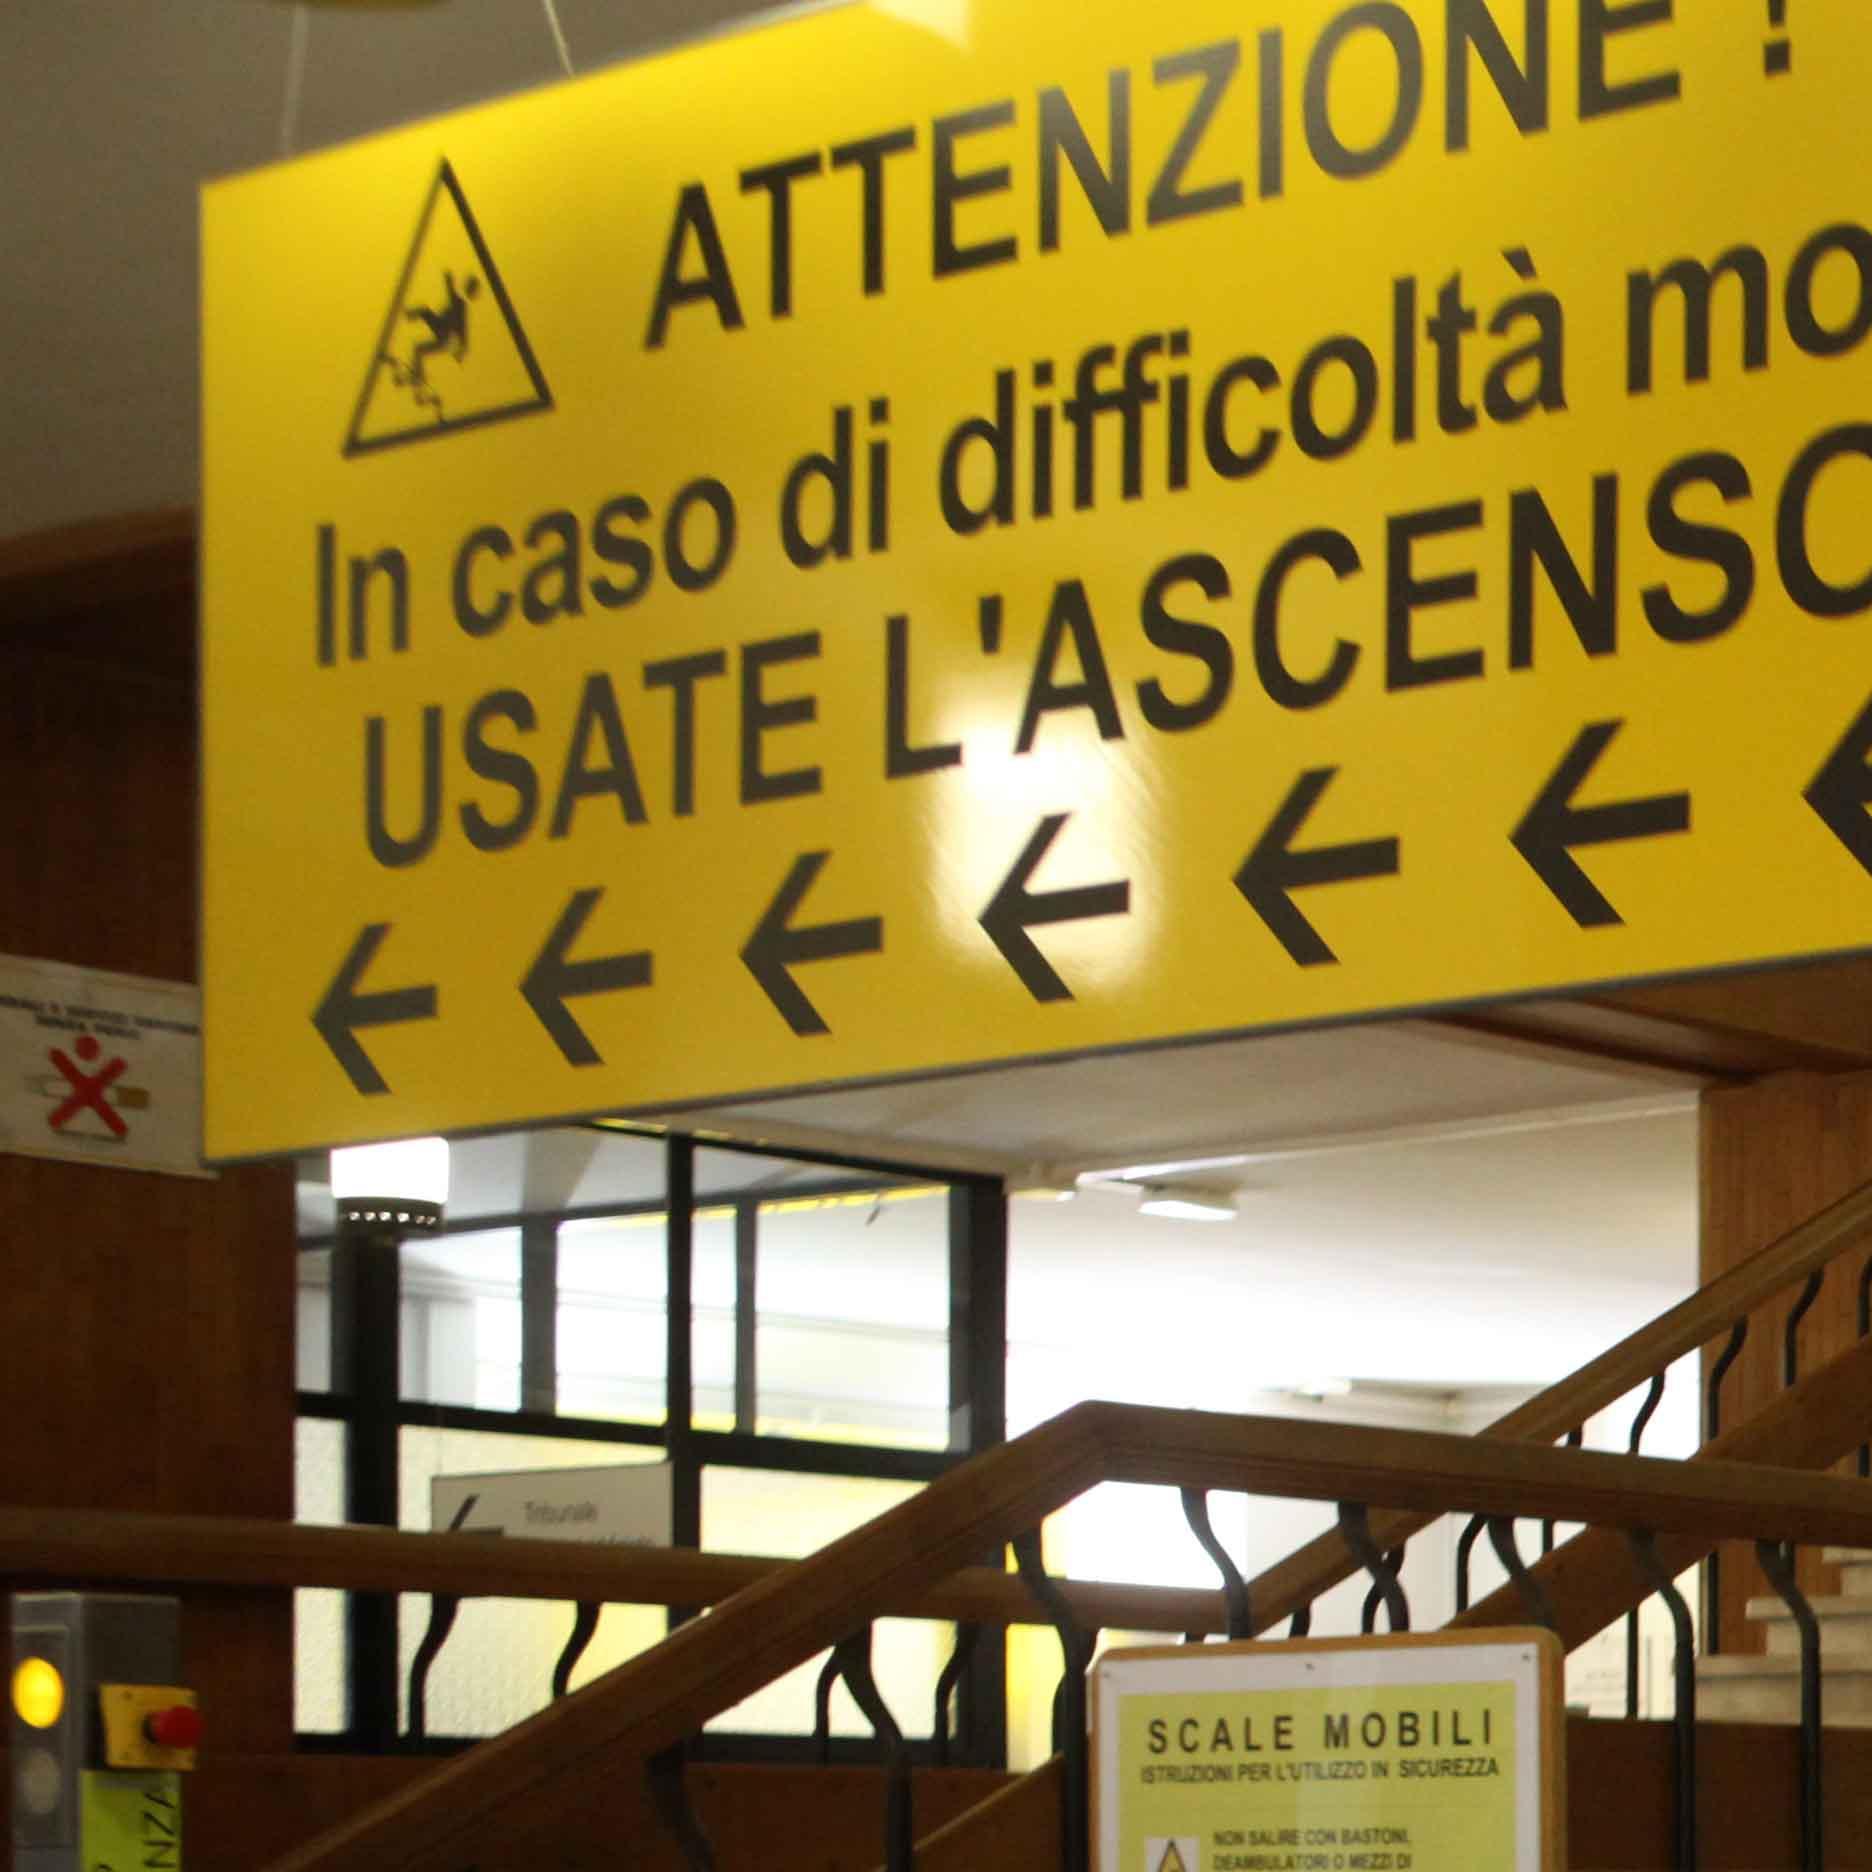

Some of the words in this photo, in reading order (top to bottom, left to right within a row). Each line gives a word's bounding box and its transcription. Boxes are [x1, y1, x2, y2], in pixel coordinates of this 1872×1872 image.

[642, 0, 1683, 350] ATTENZIONE
[315, 523, 408, 666] In
[452, 471, 734, 637] caso
[780, 406, 889, 576] di
[941, 249, 1565, 540] difficoltà
[359, 634, 822, 871] USATE
[1142, 1765, 1233, 1785] ISTRUZIONI
[1238, 1764, 1271, 1782] PER
[1276, 1761, 1366, 1781] L'UTILIZZO
[1372, 1761, 1389, 1778] IN
[1399, 1758, 1499, 1778] SICUREZZA
[1148, 1715, 1295, 1754] SCALE
[1323, 1709, 1492, 1749] MOBILI
